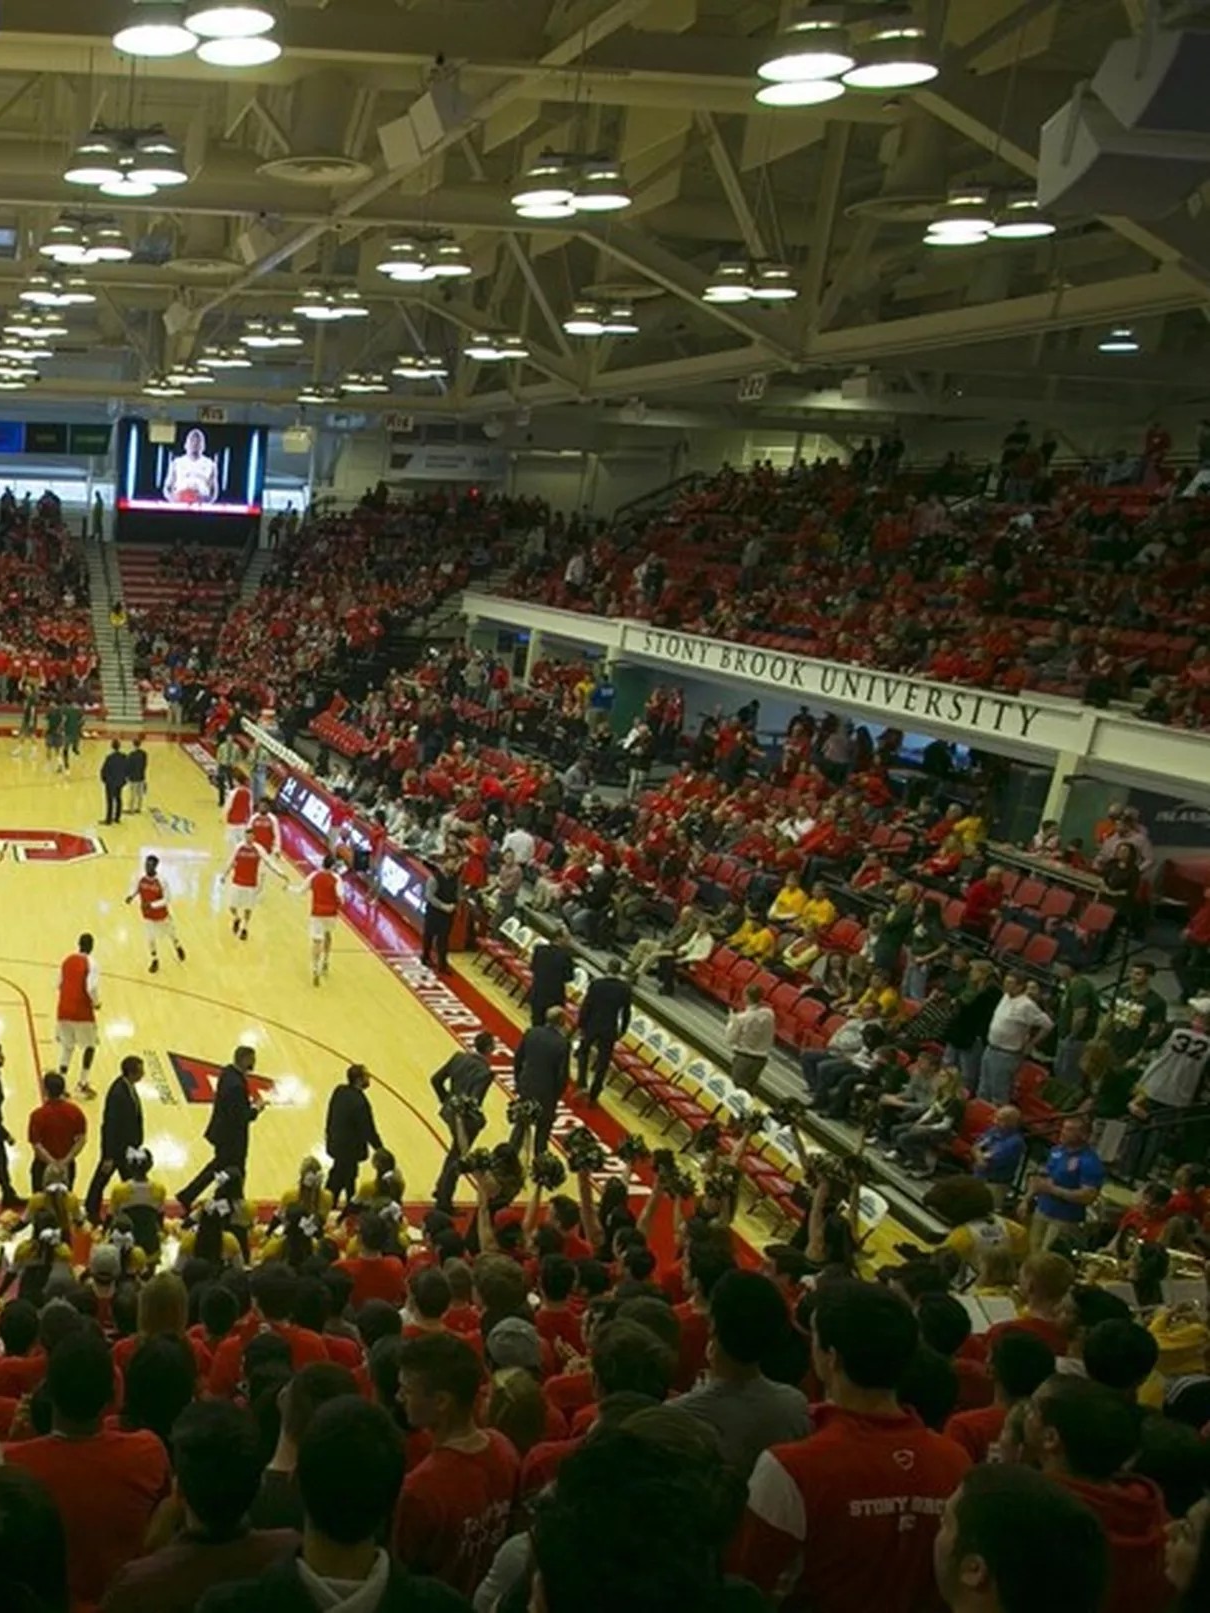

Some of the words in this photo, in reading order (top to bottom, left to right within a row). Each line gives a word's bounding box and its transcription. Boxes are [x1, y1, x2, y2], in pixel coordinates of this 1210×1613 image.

[642, 630, 710, 663] STONY
[719, 647, 807, 688] BROOK
[819, 667, 1042, 738] UNIVERSITY
[1171, 1033, 1210, 1061] 32
